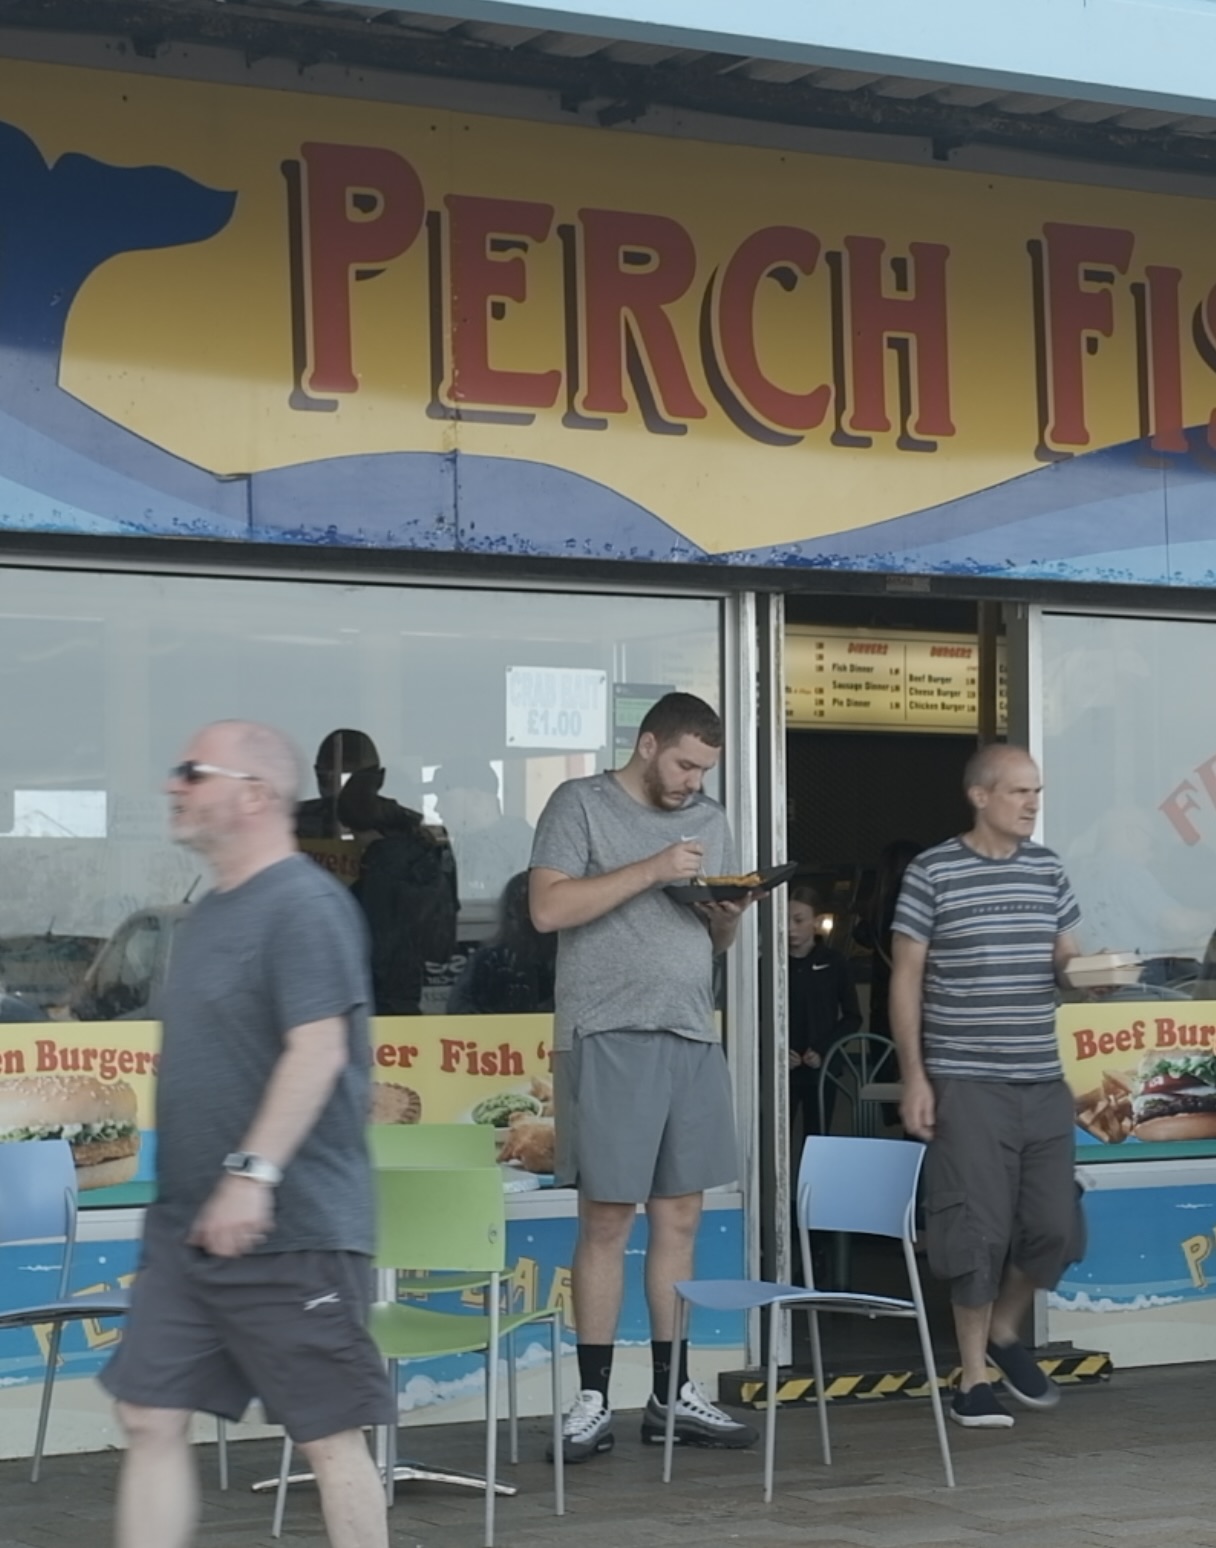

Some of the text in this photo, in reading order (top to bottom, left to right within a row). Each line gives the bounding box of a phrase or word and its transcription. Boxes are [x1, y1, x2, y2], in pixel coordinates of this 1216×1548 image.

[281, 141, 956, 453] PERCH
[849, 663, 874, 674] Dinner
[832, 679, 890, 692] Sausage Dinner
[909, 673, 953, 685] Beef Burger
[909, 687, 961, 699] Cheese Burger
[832, 697, 871, 709] Pie Dinner
[909, 700, 966, 713] Chicken Burger
[527, 708, 583, 736] £1.00
[1072, 1019, 1146, 1061] Beef
[440, 1038, 525, 1076] Fish
